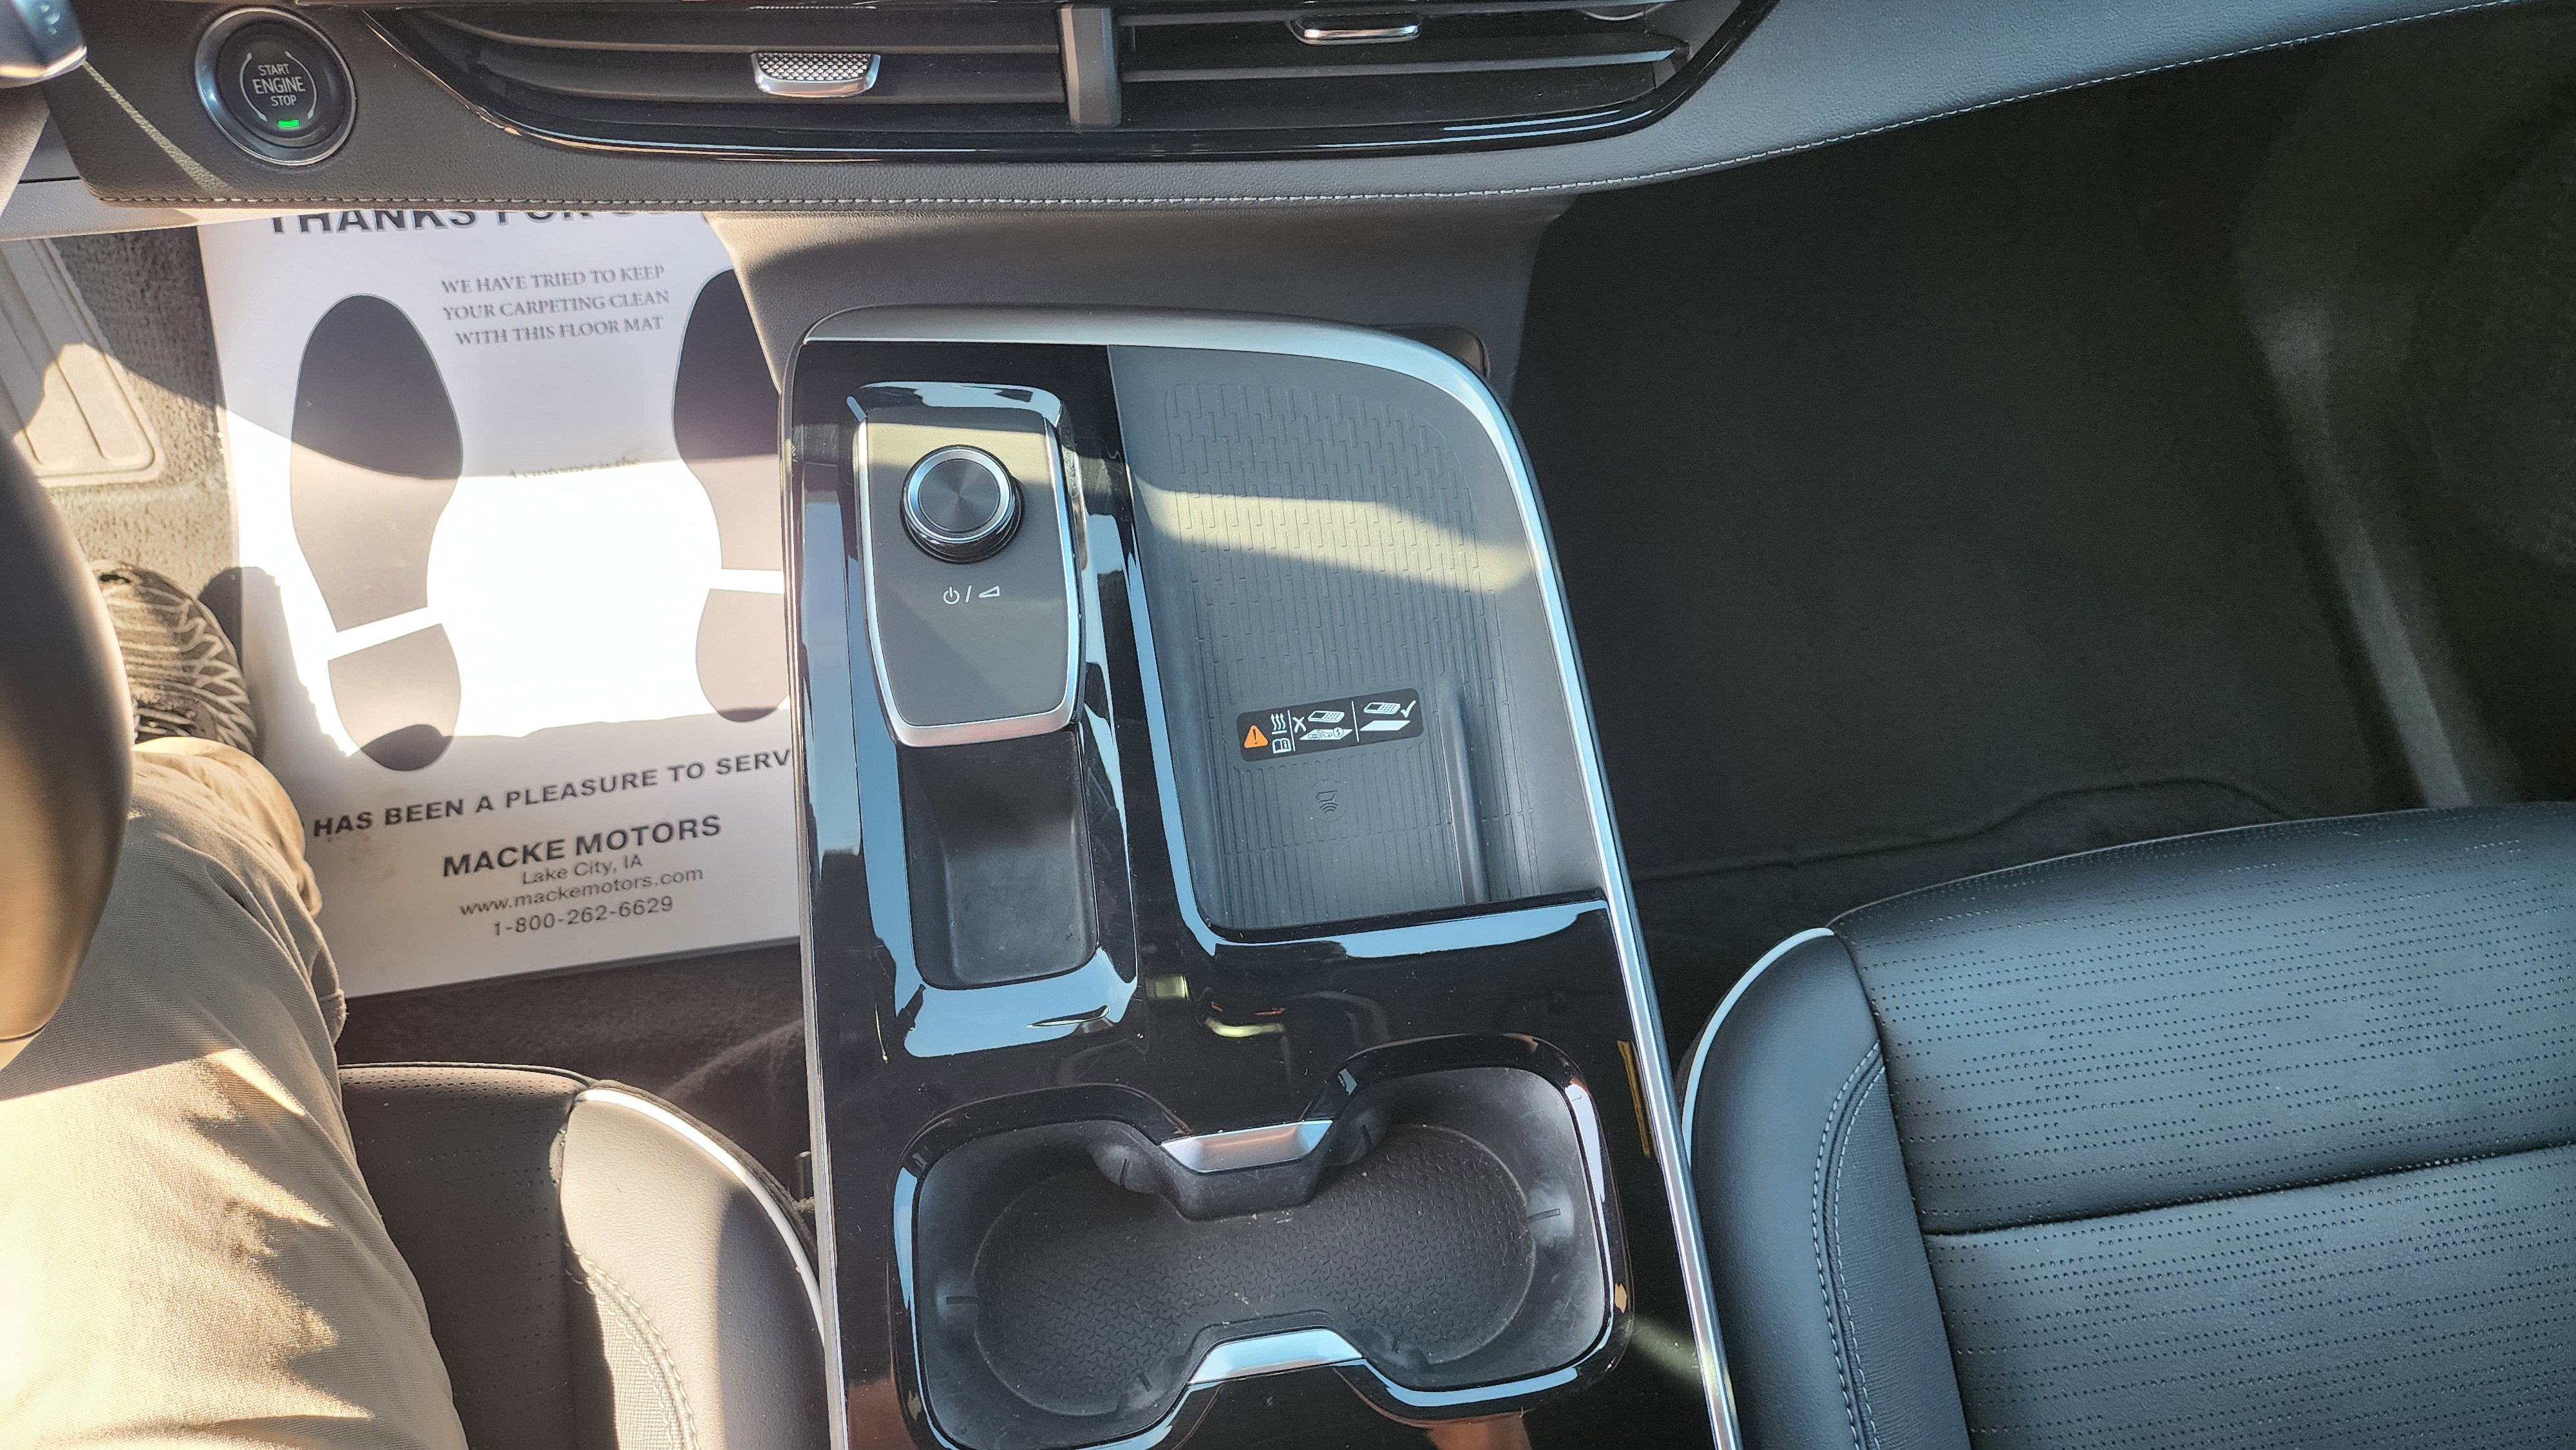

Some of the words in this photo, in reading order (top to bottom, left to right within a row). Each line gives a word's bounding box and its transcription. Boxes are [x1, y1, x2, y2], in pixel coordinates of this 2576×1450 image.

[252, 75, 306, 94] ENGINE
[258, 63, 290, 76] START
[270, 95, 296, 106] STOP
[441, 279, 472, 294] WE
[477, 275, 527, 292] HAVE
[530, 271, 586, 288] TRIED
[590, 268, 616, 284] TO
[620, 265, 665, 282] KEEP
[444, 305, 496, 321] YOUR
[500, 296, 606, 317] CARPETING
[609, 290, 669, 308] CLEAN
[456, 329, 507, 345] WITH
[513, 325, 555, 342] THIS
[560, 320, 620, 338] FLOOR
[623, 315, 665, 333] MAT
[314, 811, 373, 838] HAS
[385, 798, 464, 826] BEEN
[475, 795, 494, 813] A
[506, 769, 658, 808] PLEASURE
[668, 762, 705, 782] TO
[443, 838, 565, 877] MACKE
[576, 814, 723, 856] MOTORS
[522, 867, 568, 885] Lake
[574, 859, 618, 877] City,
[625, 854, 643, 868] IA
[460, 869, 704, 916] www.mackemotors.com
[493, 896, 674, 936] 1-800-262-6629
